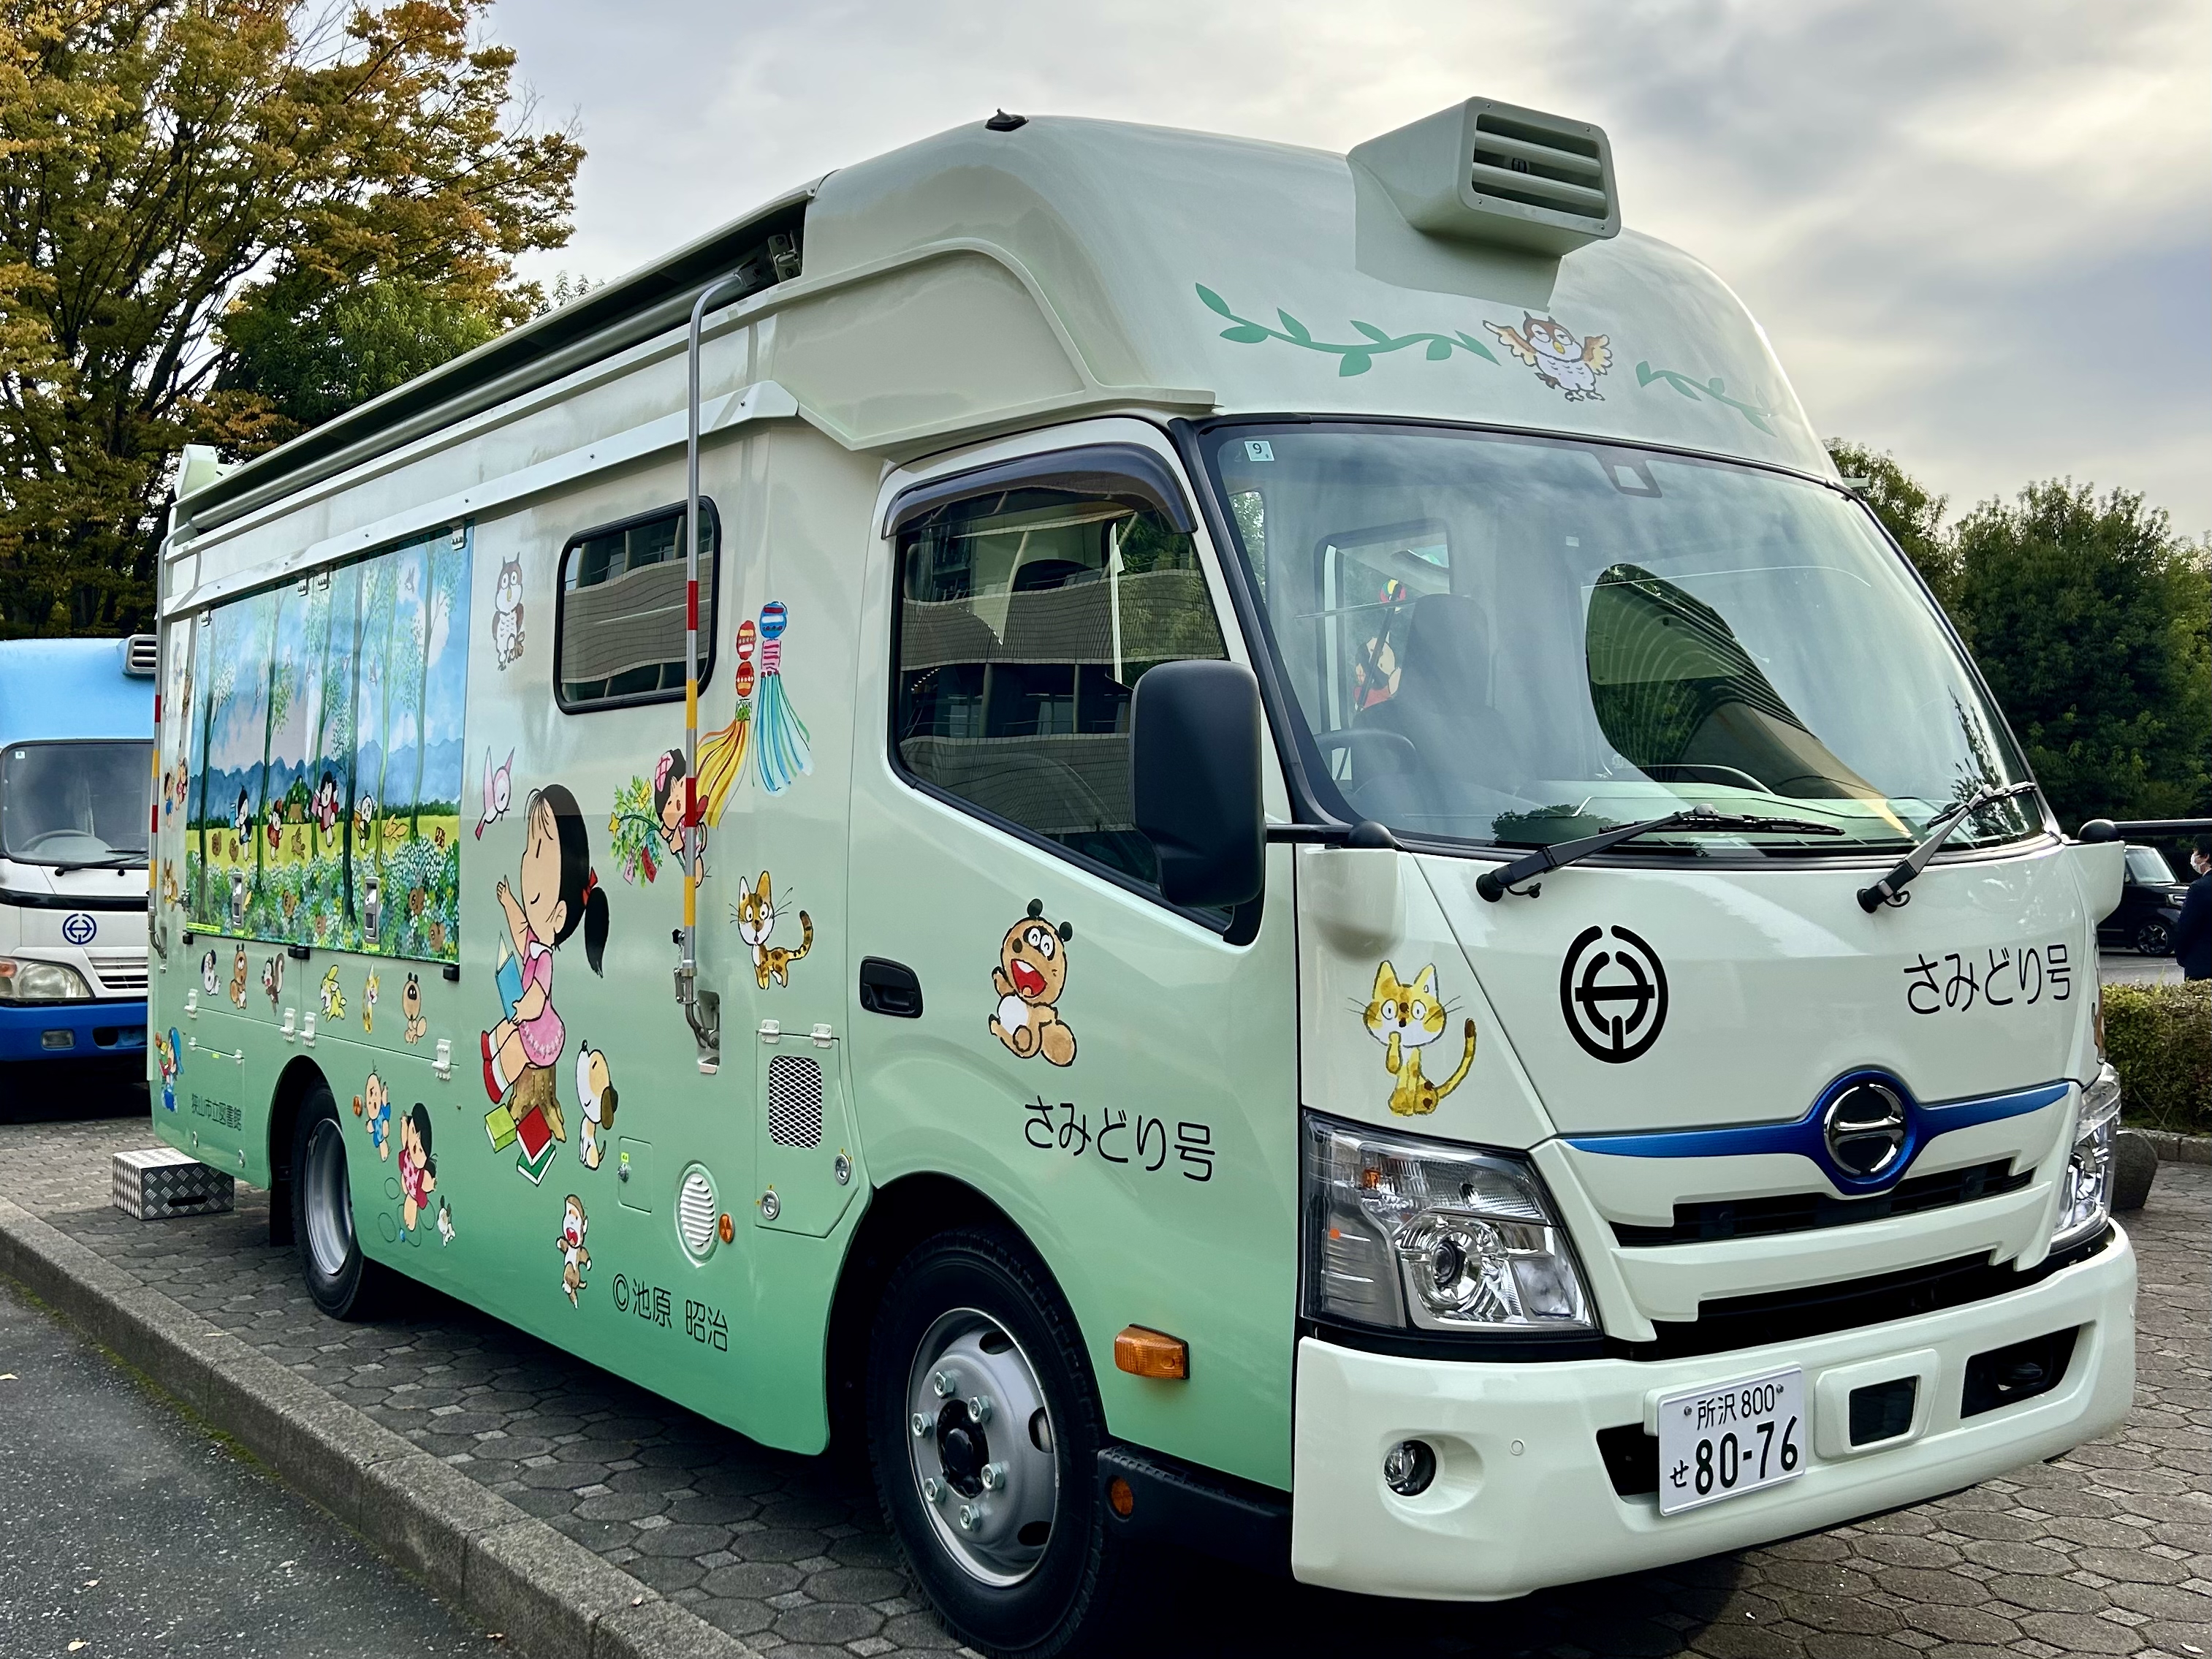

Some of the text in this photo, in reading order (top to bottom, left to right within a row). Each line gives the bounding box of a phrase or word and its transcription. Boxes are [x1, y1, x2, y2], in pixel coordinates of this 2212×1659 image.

[1253, 443, 1262, 454] 9
[1904, 944, 2071, 1014] さみどり号
[1025, 1095, 1215, 1182] さみどり号
[685, 1299, 729, 1352] 昭治
[1696, 1383, 1775, 1430] 所沢 800
[1669, 1415, 1798, 1495] せ 80-76
